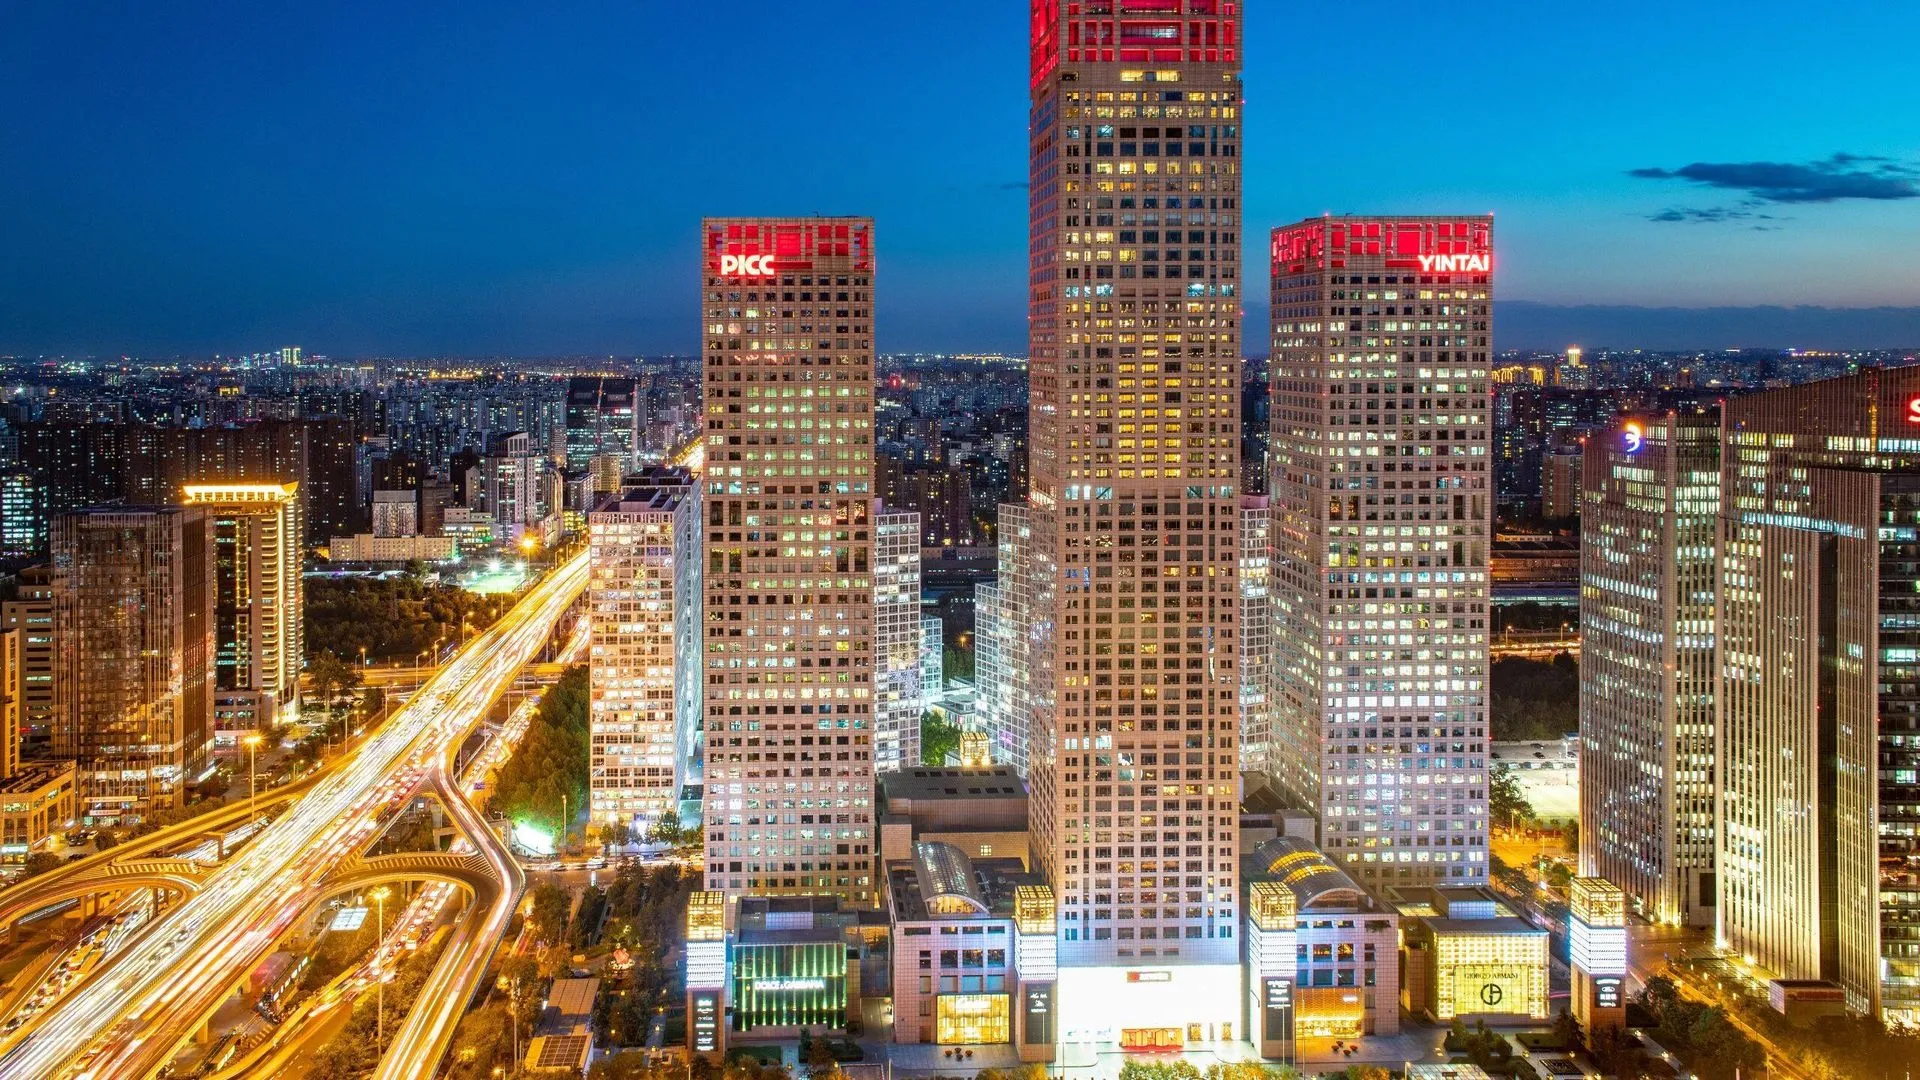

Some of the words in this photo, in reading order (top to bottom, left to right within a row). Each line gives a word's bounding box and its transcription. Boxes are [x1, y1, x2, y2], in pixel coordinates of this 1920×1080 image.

[721, 255, 775, 275] PICC
[1418, 254, 1490, 272] YINTAI
[1492, 972, 1518, 980] ARMANI
